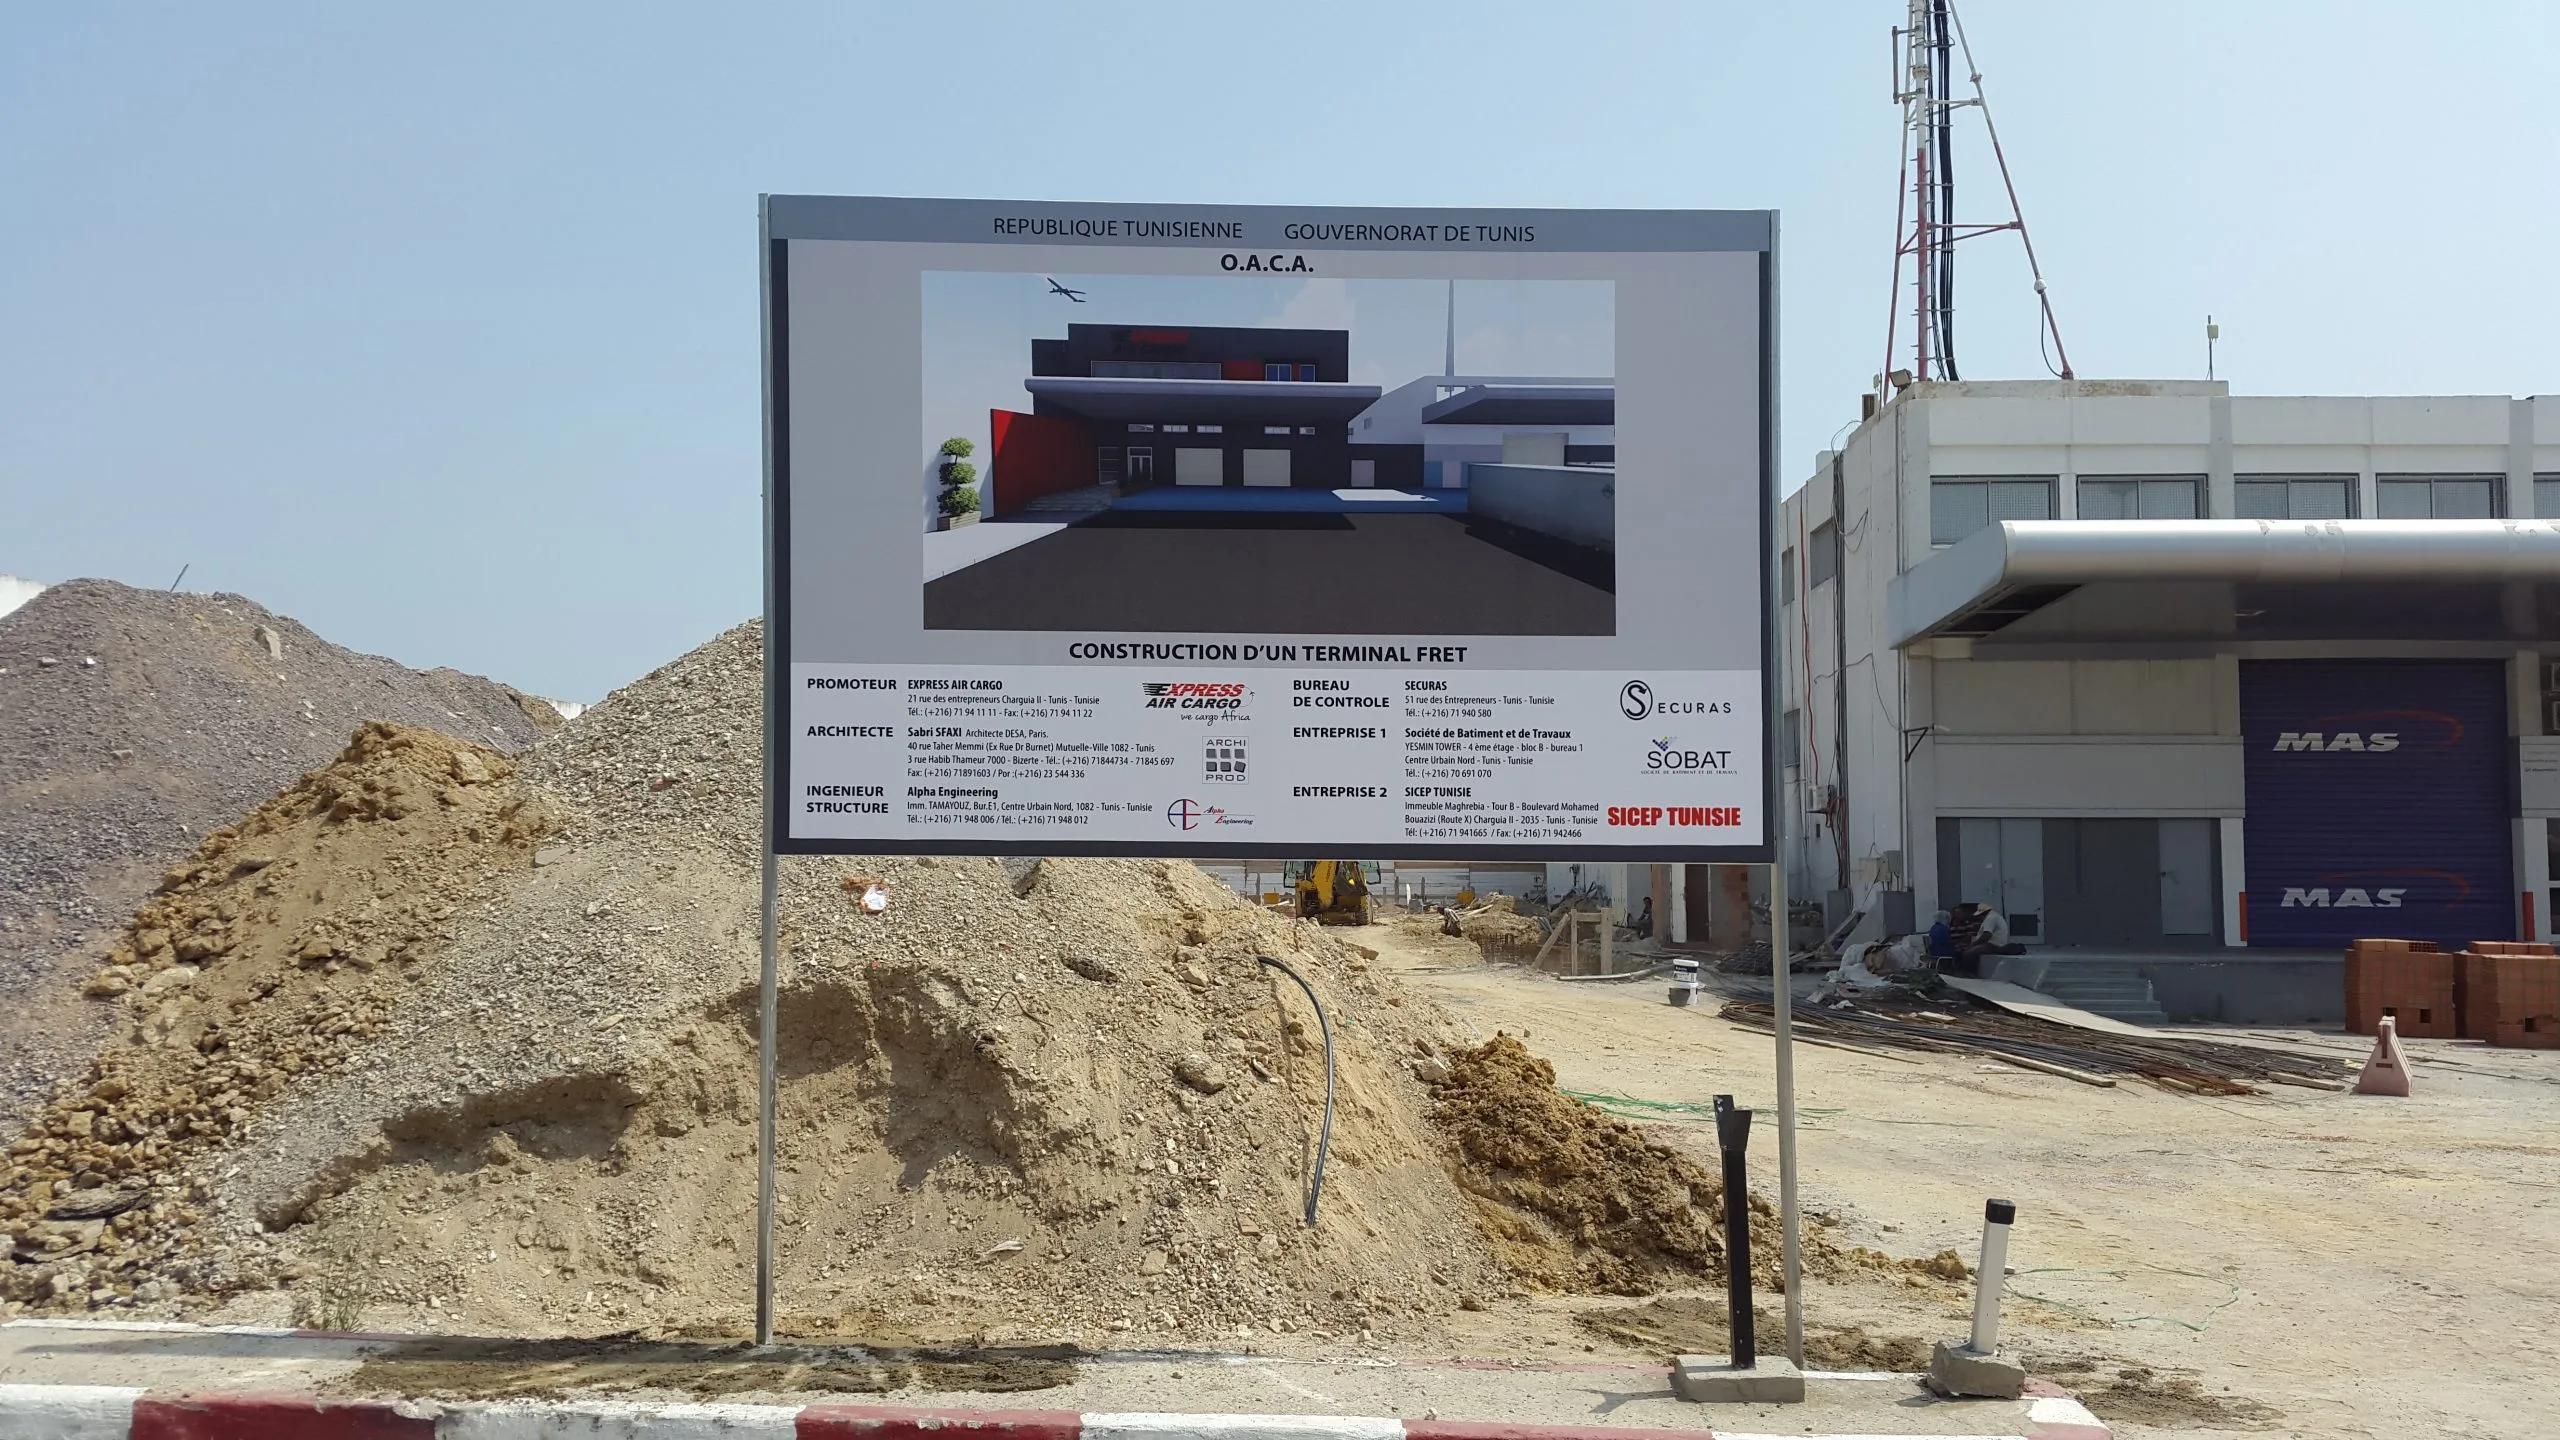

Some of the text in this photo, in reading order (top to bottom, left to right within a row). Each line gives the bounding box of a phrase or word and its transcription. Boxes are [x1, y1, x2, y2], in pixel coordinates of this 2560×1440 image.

[993, 218, 1243, 238] REPUBLIQUE TUNISIENNE
[1284, 224, 1535, 242] GOUVERNORAT DE TUNIS
[1220, 254, 1314, 273] O.A.C.A.
[1069, 642, 1237, 660] CONSTRUCTION
[1301, 645, 1412, 663] TERMINAL
[1416, 646, 1468, 664] FRET
[807, 678, 897, 691] PROMOTEUR
[907, 678, 1003, 691] EXPRESS AIR CARGO
[1142, 682, 1245, 697] EXPRESS
[1293, 679, 1350, 691] BUREAU
[1404, 679, 1448, 691] SECURAS
[907, 694, 917, 703] 21
[932, 694, 947, 703] des
[947, 695, 1001, 706] entrepreneurs
[1001, 694, 1035, 706] Charguia
[1036, 695, 1042, 704] II
[1047, 695, 1068, 705] Tunis
[1073, 695, 1100, 705] Tunisie
[1145, 697, 1242, 709] AIR CARGO
[1293, 696, 1390, 709] DE CONTROLE
[1404, 695, 1414, 704] 51
[1429, 695, 1443, 704] des
[1444, 695, 1497, 706] Entrepreneurs
[1502, 695, 1523, 705] Tunis
[1528, 695, 1555, 705] Tunisie
[1180, 710, 1251, 726] we cargo Africa
[1421, 707, 1449, 718] (+216)
[1450, 708, 1460, 717] 71
[1461, 708, 1477, 718] 940
[1477, 708, 1492, 718] 580
[806, 726, 894, 738] ARCHITECTE
[907, 726, 1049, 739] Sabri SFAXI Architecte DESA, Paris.
[1293, 727, 1386, 739] ENTREPRISE 1
[1404, 727, 1572, 740] Société de Batiment et de Travaux
[907, 741, 1155, 753] 40 rue Taher Memmi (Ex Rue Dr Burnet) Mutuelle-Ville 1082 Tunis
[1206, 738, 1246, 747] ARCHI
[1404, 741, 1583, 754] YESMIN TOWER 4 ème étage bloc B bureau 1
[2272, 732, 2400, 752] MAS
[907, 754, 913, 764] 3
[914, 756, 927, 764] rue
[928, 753, 951, 764] Habib
[951, 754, 986, 765] Thameur
[986, 755, 1006, 765] 7000
[1012, 756, 1039, 766] Bizerte
[1061, 756, 1090, 766] (+216)
[1091, 756, 1129, 766] 71844734
[1404, 755, 1534, 766] Centre Urbain Nord Tunis Tunisie
[1646, 750, 1732, 769] SOBAT
[907, 767, 923, 777] Fax:
[924, 767, 952, 778] (+216)
[953, 768, 991, 778] 71891603
[1043, 769, 1053, 778] 23
[1054, 769, 1069, 779] 544
[1070, 769, 1085, 779] 336
[1205, 773, 1246, 782] PROD
[806, 785, 884, 798] INGENIEUR
[907, 786, 999, 800] Alpha Engineering
[1293, 786, 1388, 798] ENTREPRISE 2
[1404, 786, 1472, 798] SICEP TUNISIE
[806, 802, 889, 815] STRUCTURE
[907, 801, 928, 810] Imm.
[928, 800, 972, 811] TAMAYOUZ,
[1000, 801, 1026, 811] Centre
[1026, 801, 1052, 811] Urbain
[1053, 802, 1074, 812] Nord,
[1076, 802, 1095, 811] 1082
[1100, 802, 1121, 812] Tunis
[1126, 802, 1153, 812] Tunisie
[1404, 801, 1599, 813] Immeuble Maghrebia Tour B Boulevard Mohamed
[1404, 814, 1598, 827] Bouazizi (Route X) Charguia II 2035 Tunis Tunisie
[1607, 806, 1742, 827] SICEP TUNISIE
[1404, 827, 1582, 840] Tél: (+216) 71 941665 Fax: (+216) 71 942466
[2280, 887, 2407, 908] MAS
